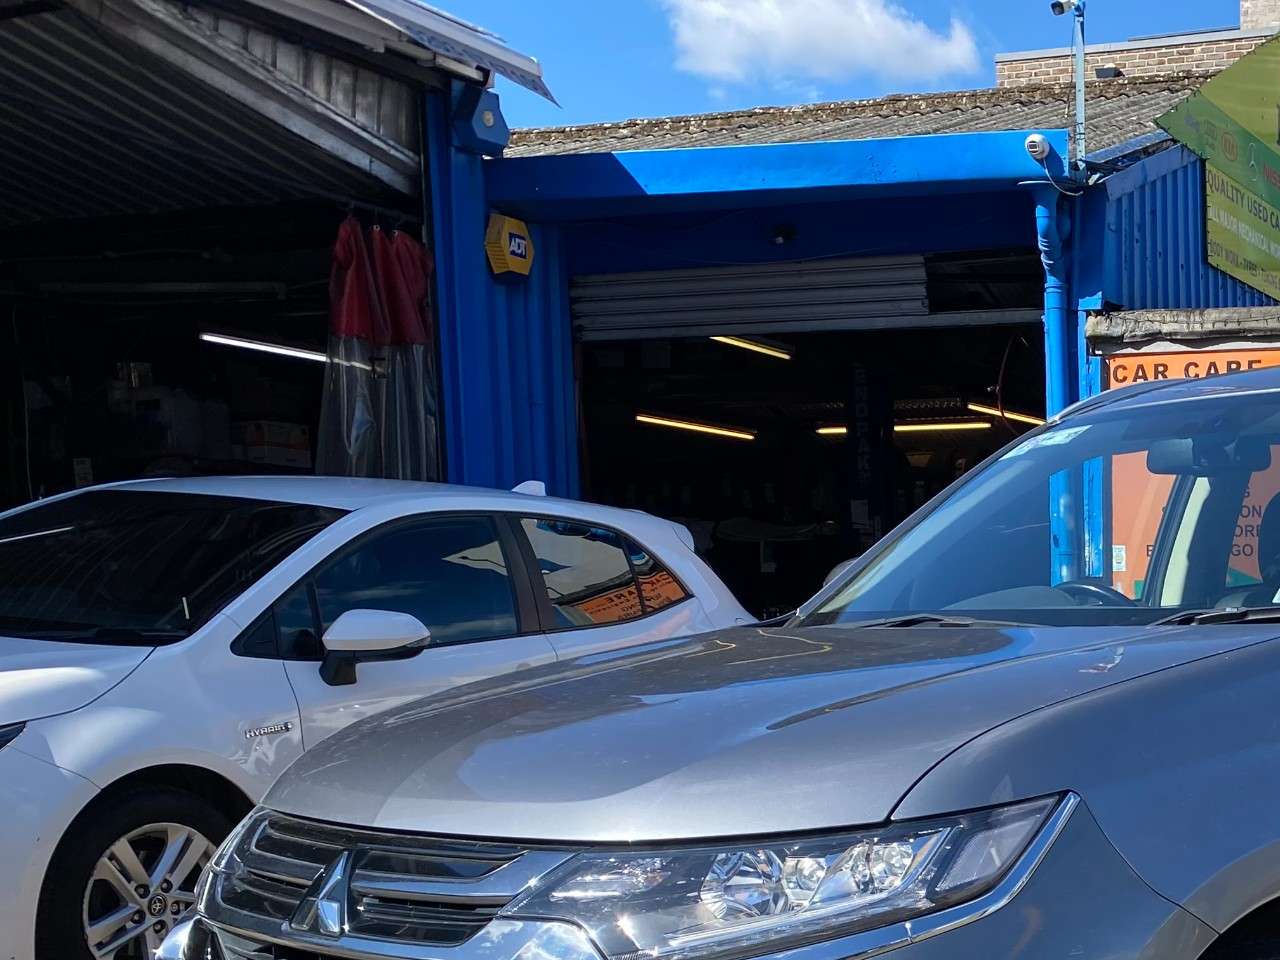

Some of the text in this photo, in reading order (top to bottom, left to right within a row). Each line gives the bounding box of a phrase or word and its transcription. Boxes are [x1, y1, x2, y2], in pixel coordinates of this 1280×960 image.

[1206, 168, 1245, 208] QUALITY
[1247, 195, 1269, 223] USED
[509, 236, 527, 256] ADT
[1112, 363, 1169, 384] CAR
